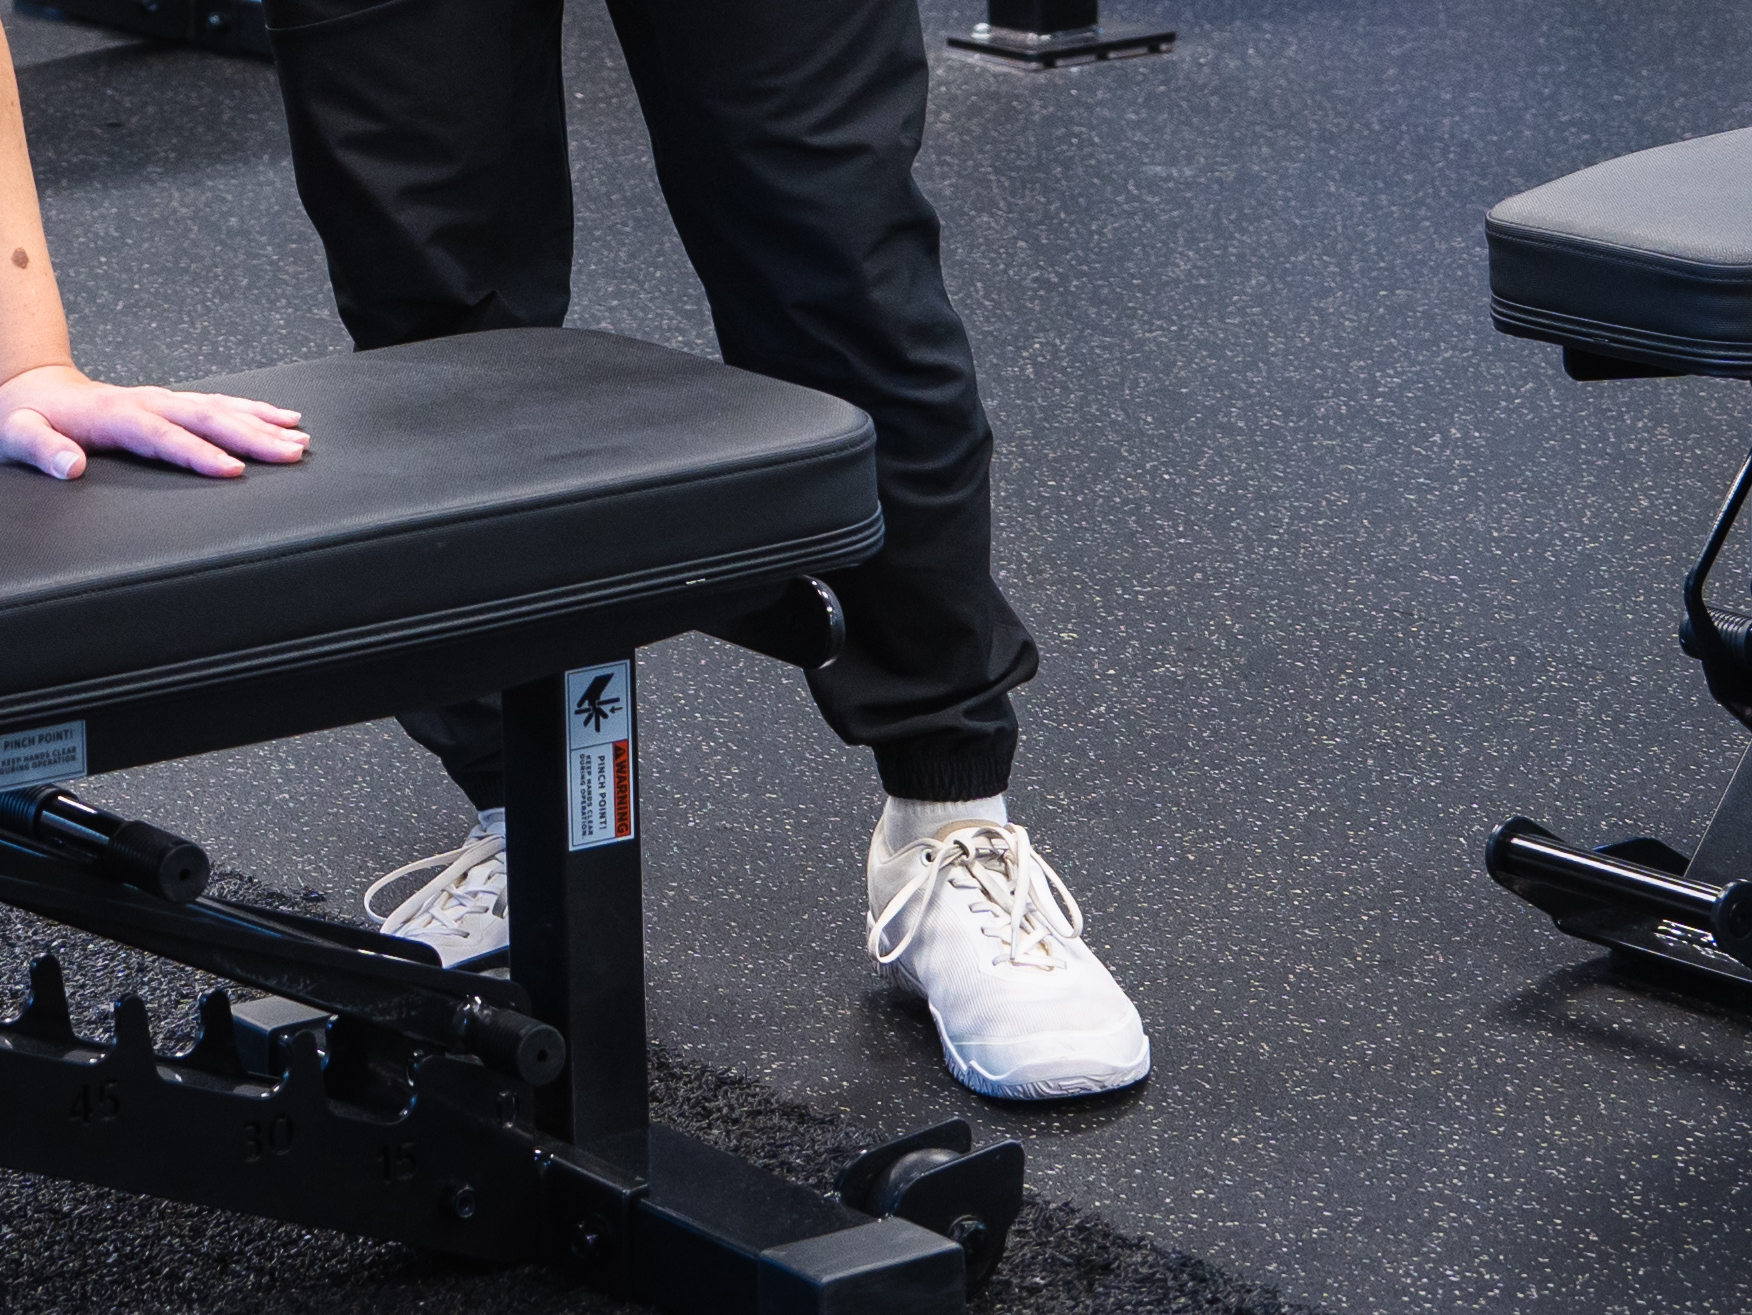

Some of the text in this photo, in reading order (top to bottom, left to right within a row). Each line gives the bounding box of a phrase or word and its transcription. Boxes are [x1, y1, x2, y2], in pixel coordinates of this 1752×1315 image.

[3, 729, 73, 751] PINCH POINT!
[597, 755, 607, 830] PINCH POINT!
[616, 759, 629, 834] WARNING
[69, 1079, 121, 1124] 45
[243, 1115, 294, 1164] 30
[377, 1142, 417, 1184] 15
